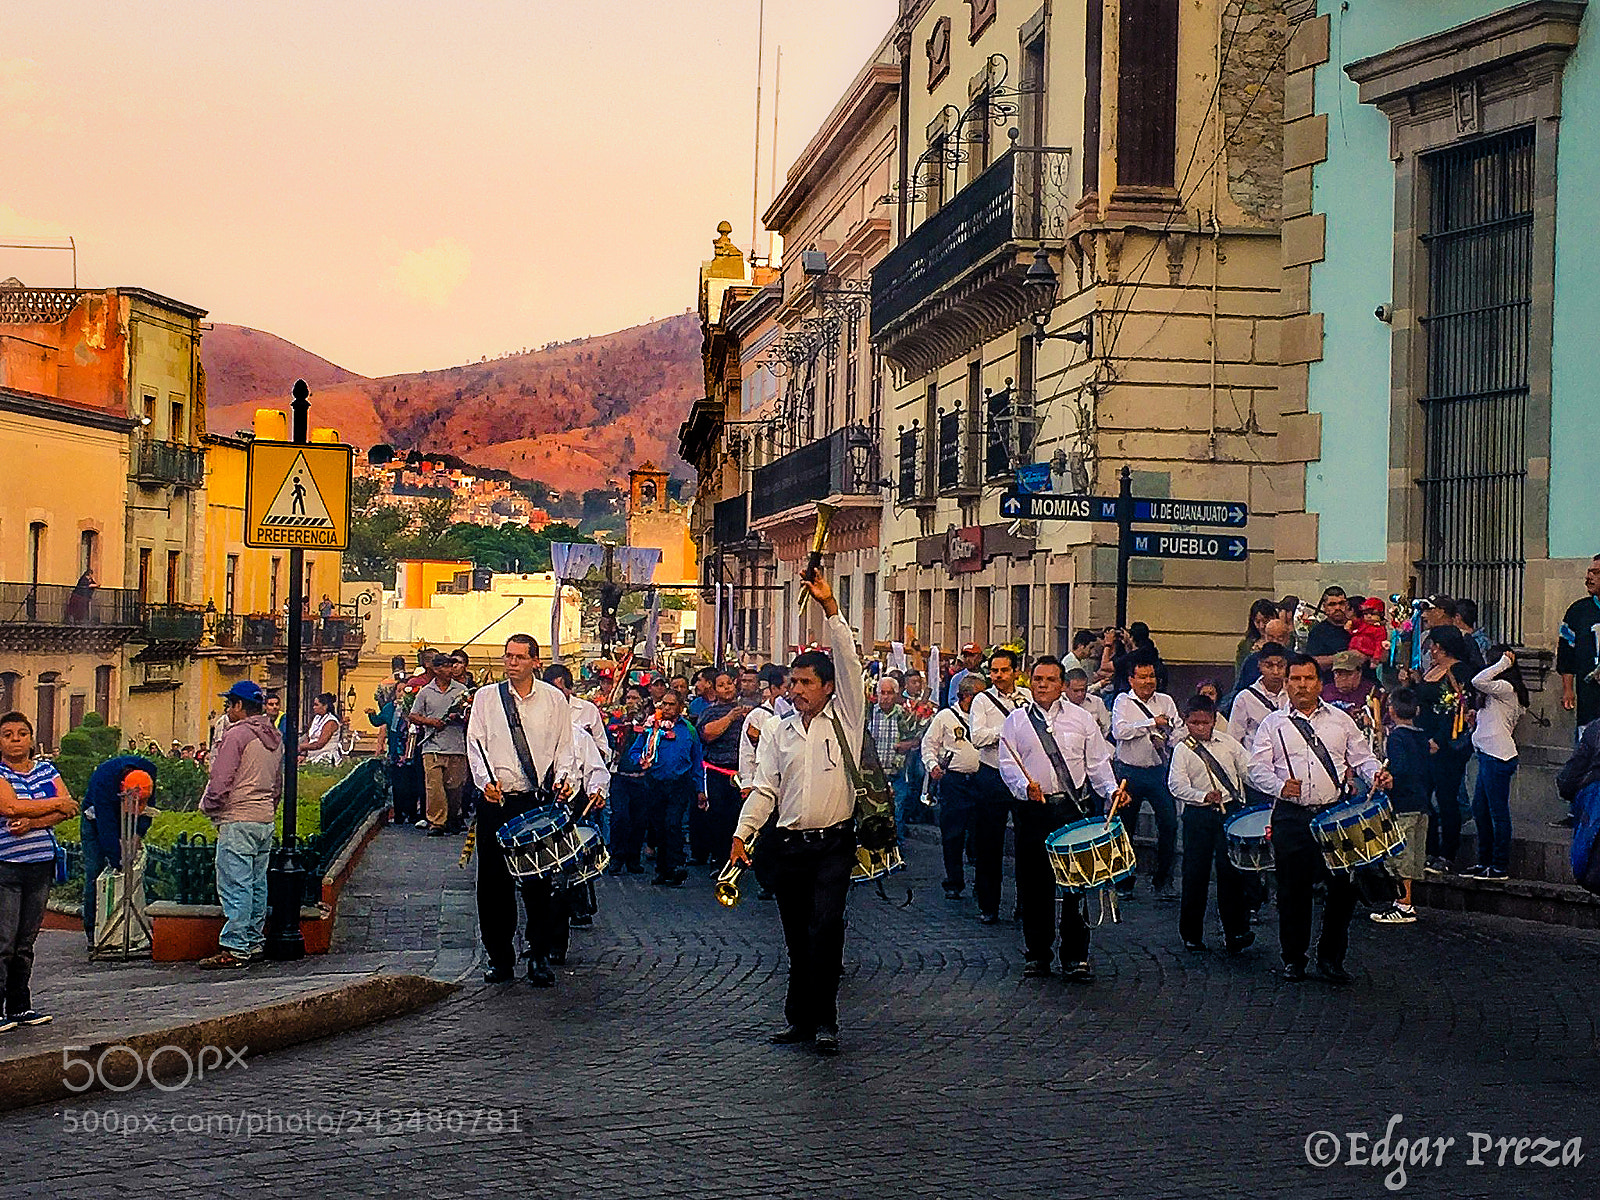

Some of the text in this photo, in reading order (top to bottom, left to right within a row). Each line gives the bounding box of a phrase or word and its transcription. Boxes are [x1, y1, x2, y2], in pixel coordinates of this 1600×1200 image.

[1030, 499, 1090, 517] MOMIAS
[1160, 504, 1172, 519] DE
[1173, 504, 1228, 522] GUANAJUATO
[257, 527, 338, 545] PREFERENCIA
[1159, 537, 1219, 555] PUEBLO
